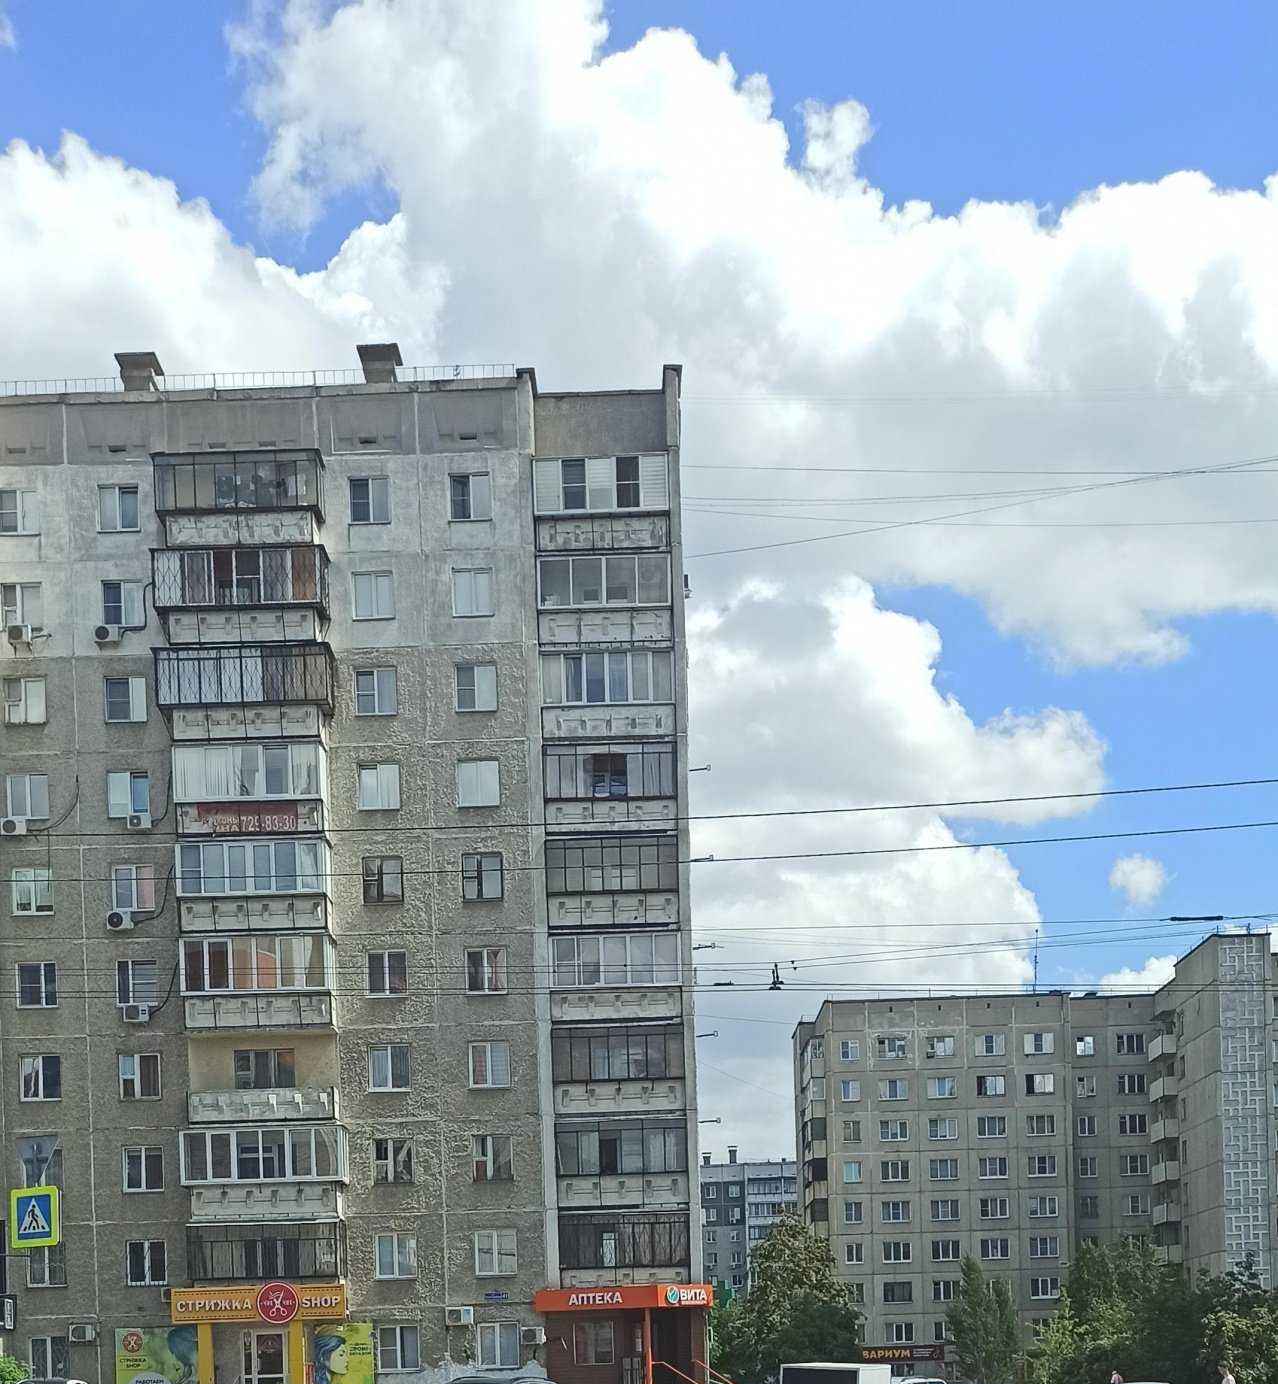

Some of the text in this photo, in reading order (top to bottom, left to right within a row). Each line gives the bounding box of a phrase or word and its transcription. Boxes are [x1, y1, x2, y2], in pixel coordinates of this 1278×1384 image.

[302, 1295, 341, 1308] SHOP
[568, 1291, 623, 1306] АПТЕКА
[680, 1288, 708, 1301] ВИТА
[176, 1298, 252, 1313] СТРИЖКА
